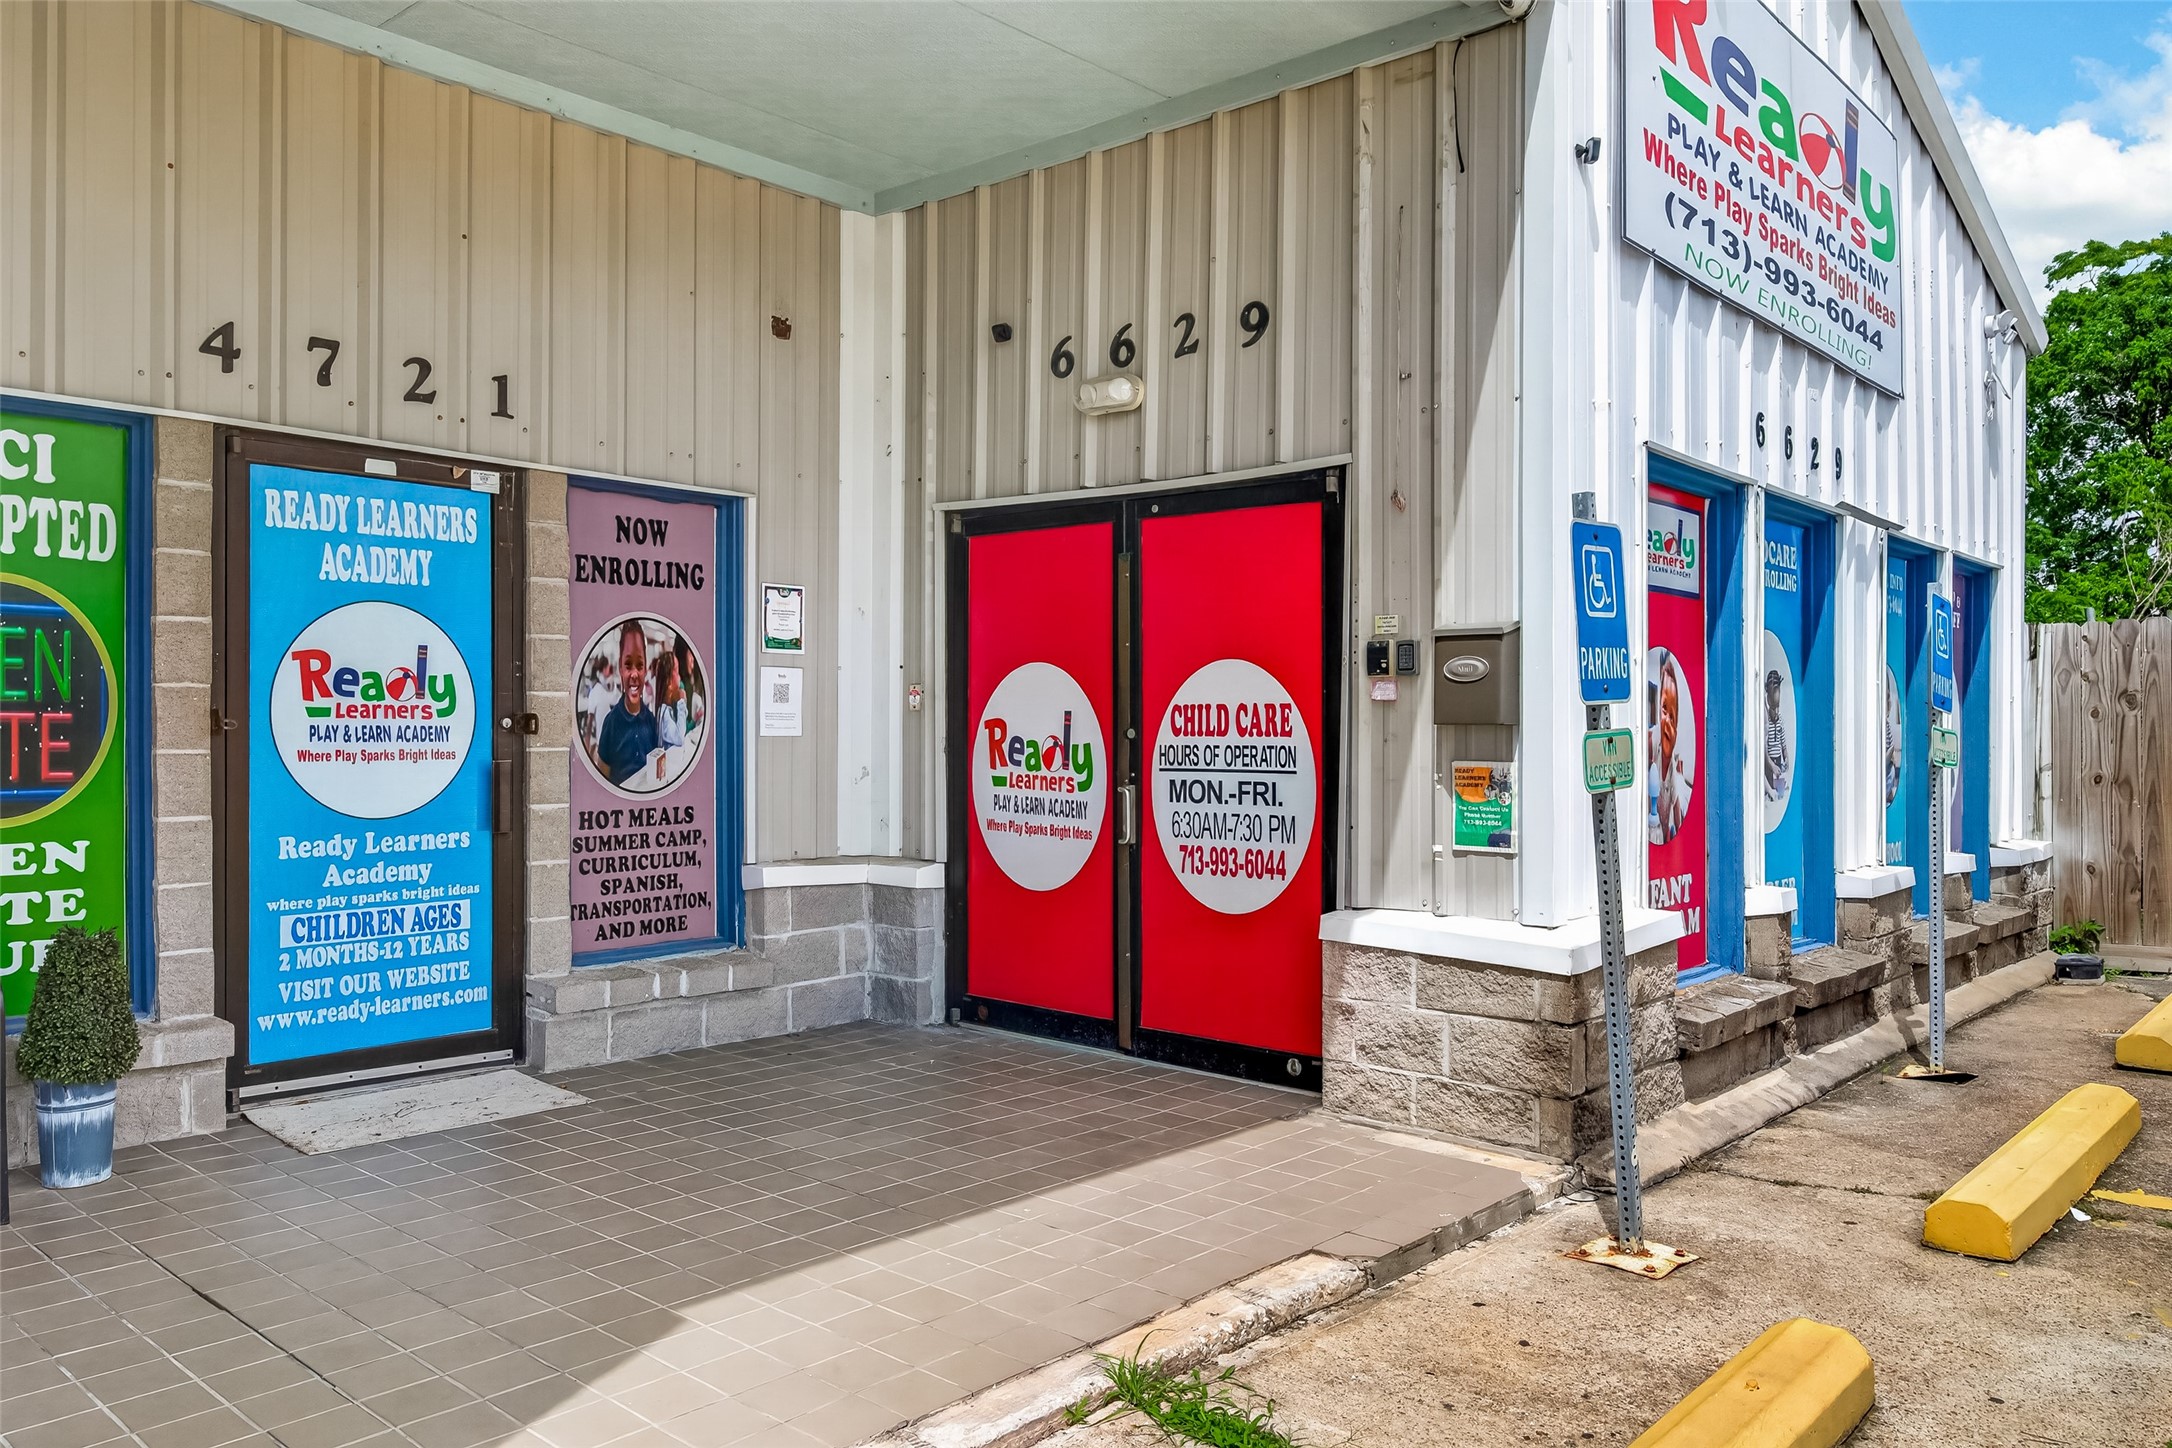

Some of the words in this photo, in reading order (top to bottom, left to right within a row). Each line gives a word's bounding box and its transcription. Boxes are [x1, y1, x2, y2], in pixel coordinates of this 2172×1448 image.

[1652, 0, 1896, 262] Ready
[1715, 104, 1866, 249] Learners
[1668, 113, 1720, 172] PLAY
[1729, 162, 1743, 191] &
[1750, 177, 1808, 238] LEARN
[1815, 225, 1888, 295] ACADEMY
[1643, 127, 1707, 200] Where
[1714, 180, 1753, 236] Play
[1758, 213, 1814, 271] Sparks
[1819, 250, 1859, 304] Bright
[1864, 286, 1896, 329] Ideas
[1665, 191, 1883, 352] (713)-993-6044
[1685, 242, 1750, 295] NOW
[1758, 287, 1872, 370] ENROLLING!
[265, 489, 350, 533] READY
[356, 497, 477, 544] LEARNERS
[615, 515, 668, 547] NOW
[319, 542, 432, 586] ACADEMY
[575, 554, 704, 591] ENROLLING
[1581, 647, 1627, 680] PARKING
[292, 645, 457, 718] Ready
[335, 702, 433, 720] Learners
[1170, 703, 1230, 737] CHILD
[1235, 702, 1292, 738] CARE
[310, 724, 339, 743] PLAY
[343, 725, 352, 743] &
[355, 725, 392, 743] LEARN
[396, 725, 450, 743] ACADEMY
[1602, 740, 1617, 756] VAN
[297, 750, 331, 762] Where
[335, 750, 357, 764] Play
[361, 749, 395, 764] Sparks
[399, 749, 428, 763] Bright
[431, 749, 456, 760] Ideas
[984, 710, 1093, 792] Ready
[1159, 744, 1199, 766] HOURS
[1203, 745, 1220, 767] OF
[1224, 745, 1297, 768] OPERATION
[1009, 772, 1075, 794] Learners
[1590, 761, 1631, 782] ACCESSIBLE
[994, 794, 1011, 811] PLAY
[1014, 795, 1019, 813] &
[1021, 796, 1045, 816] LEARN
[1048, 798, 1088, 820] ACADEMY
[1169, 779, 1283, 807] MON.-FRI.
[579, 810, 623, 830] HOT
[628, 806, 694, 828] MEALS
[987, 818, 1007, 832] Where
[1009, 820, 1023, 837] Play
[1024, 822, 1048, 837] Sparks
[1050, 824, 1071, 841] Bright
[1073, 825, 1092, 840] Ideas
[1172, 811, 1262, 842] 6:30AM-7:30
[1269, 815, 1296, 844] PM
[278, 833, 357, 861] Ready
[365, 831, 471, 854] Learners
[572, 833, 650, 854] SUMMER
[655, 829, 707, 848] CAMP,
[322, 861, 432, 887] Academy
[579, 851, 701, 875] CURRICULUM,
[1179, 844, 1286, 881] 713-993-6044
[266, 898, 312, 912] where
[317, 894, 347, 908] play
[352, 890, 398, 906] sparks
[402, 886, 444, 901] bright
[448, 884, 480, 896] ideas
[600, 873, 683, 896] SPANISH,
[571, 891, 711, 921] TRANSPORTATION,
[291, 908, 405, 944] CHILDREN
[410, 903, 462, 932] AGES
[595, 921, 635, 942] AND
[639, 915, 688, 937] MORE
[279, 953, 290, 972] 2
[296, 940, 403, 970] MONTHS-12
[408, 931, 469, 958] YEARS
[279, 977, 334, 1003] VISIT
[340, 972, 381, 996] OUR
[387, 961, 470, 990] WEBSITE
[257, 986, 488, 1032] www.ready-learners.com
